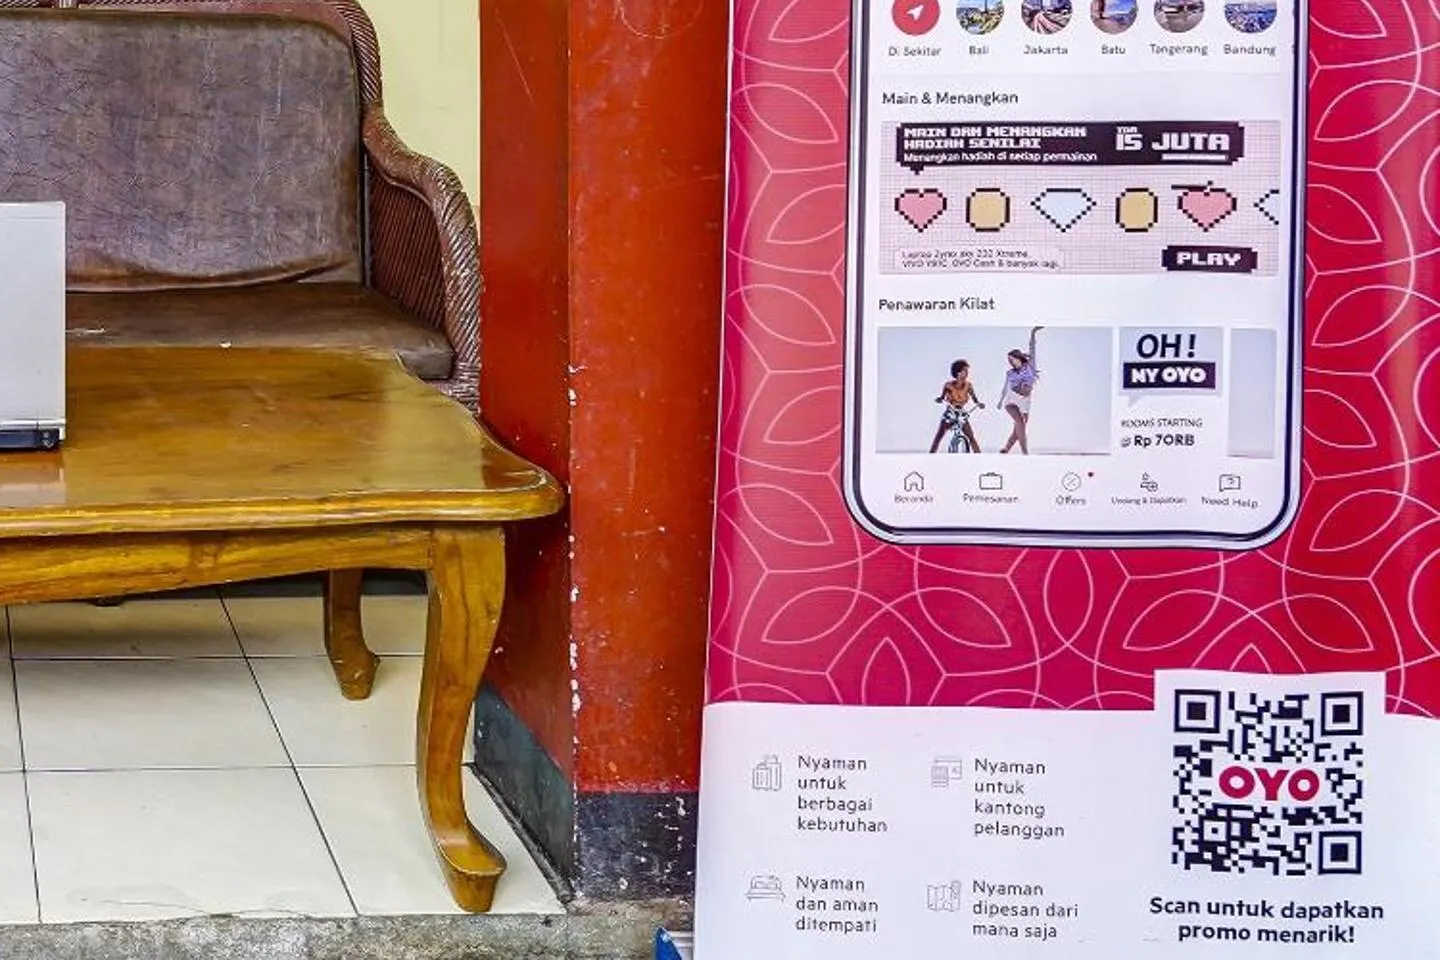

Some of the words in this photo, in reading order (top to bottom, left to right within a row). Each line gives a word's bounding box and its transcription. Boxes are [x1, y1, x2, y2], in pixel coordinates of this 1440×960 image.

[903, 46, 941, 56] Sekitar
[969, 45, 989, 54] Bali
[1023, 45, 1068, 54] Jakarta
[1101, 44, 1126, 54] Batu
[1150, 43, 1208, 56] Tangerang
[1223, 44, 1276, 56] Bandung
[882, 92, 918, 105] Main
[921, 92, 932, 105] &
[935, 91, 1018, 106] Menangkan
[904, 127, 947, 137] MAIN
[950, 126, 981, 137] DAN
[986, 126, 1086, 137] MENANGKAN
[904, 139, 964, 149] HADIAH
[969, 138, 1041, 148] SENILAI
[1116, 134, 1143, 150] 15
[1151, 133, 1229, 150] JUTA
[962, 152, 995, 161] hadiah
[997, 151, 1007, 160] di
[1042, 152, 1097, 162] permainan
[1177, 252, 1241, 267] PLAY
[878, 298, 956, 311] Penawaran
[959, 297, 995, 311] Kilat
[1162, 367, 1206, 383] OYO
[1121, 419, 1155, 428] ROOMS
[1157, 418, 1203, 428] STARTING
[1134, 435, 1152, 448] Rp
[1155, 434, 1195, 446] 70RB
[1056, 496, 1086, 505] Offers
[1202, 497, 1229, 506] Need
[1232, 499, 1258, 509] Help
[798, 754, 868, 776] Nyaman
[974, 758, 1046, 778] Nyaman
[798, 775, 847, 791] untuk
[974, 778, 1025, 795] untuk
[1218, 765, 1320, 802] OYO
[798, 795, 873, 816] berbagai
[974, 798, 1046, 819] kantong
[797, 816, 887, 833] kebutuhan
[974, 820, 1065, 840] pelanggan
[796, 875, 865, 895] Nyaman
[972, 880, 1044, 900] Nyaman
[796, 895, 827, 912] dan
[832, 900, 880, 913] aman
[972, 900, 1040, 922] dipesan
[1046, 901, 1078, 918] dari
[1150, 898, 1200, 915] Scan
[1207, 898, 1275, 918] untuk
[1281, 898, 1384, 924] dapatkan
[796, 915, 877, 935] ditempati
[972, 922, 1018, 938] mana
[1023, 922, 1058, 941] saja
[1178, 924, 1251, 945] promo
[1257, 923, 1355, 943] menarik!
